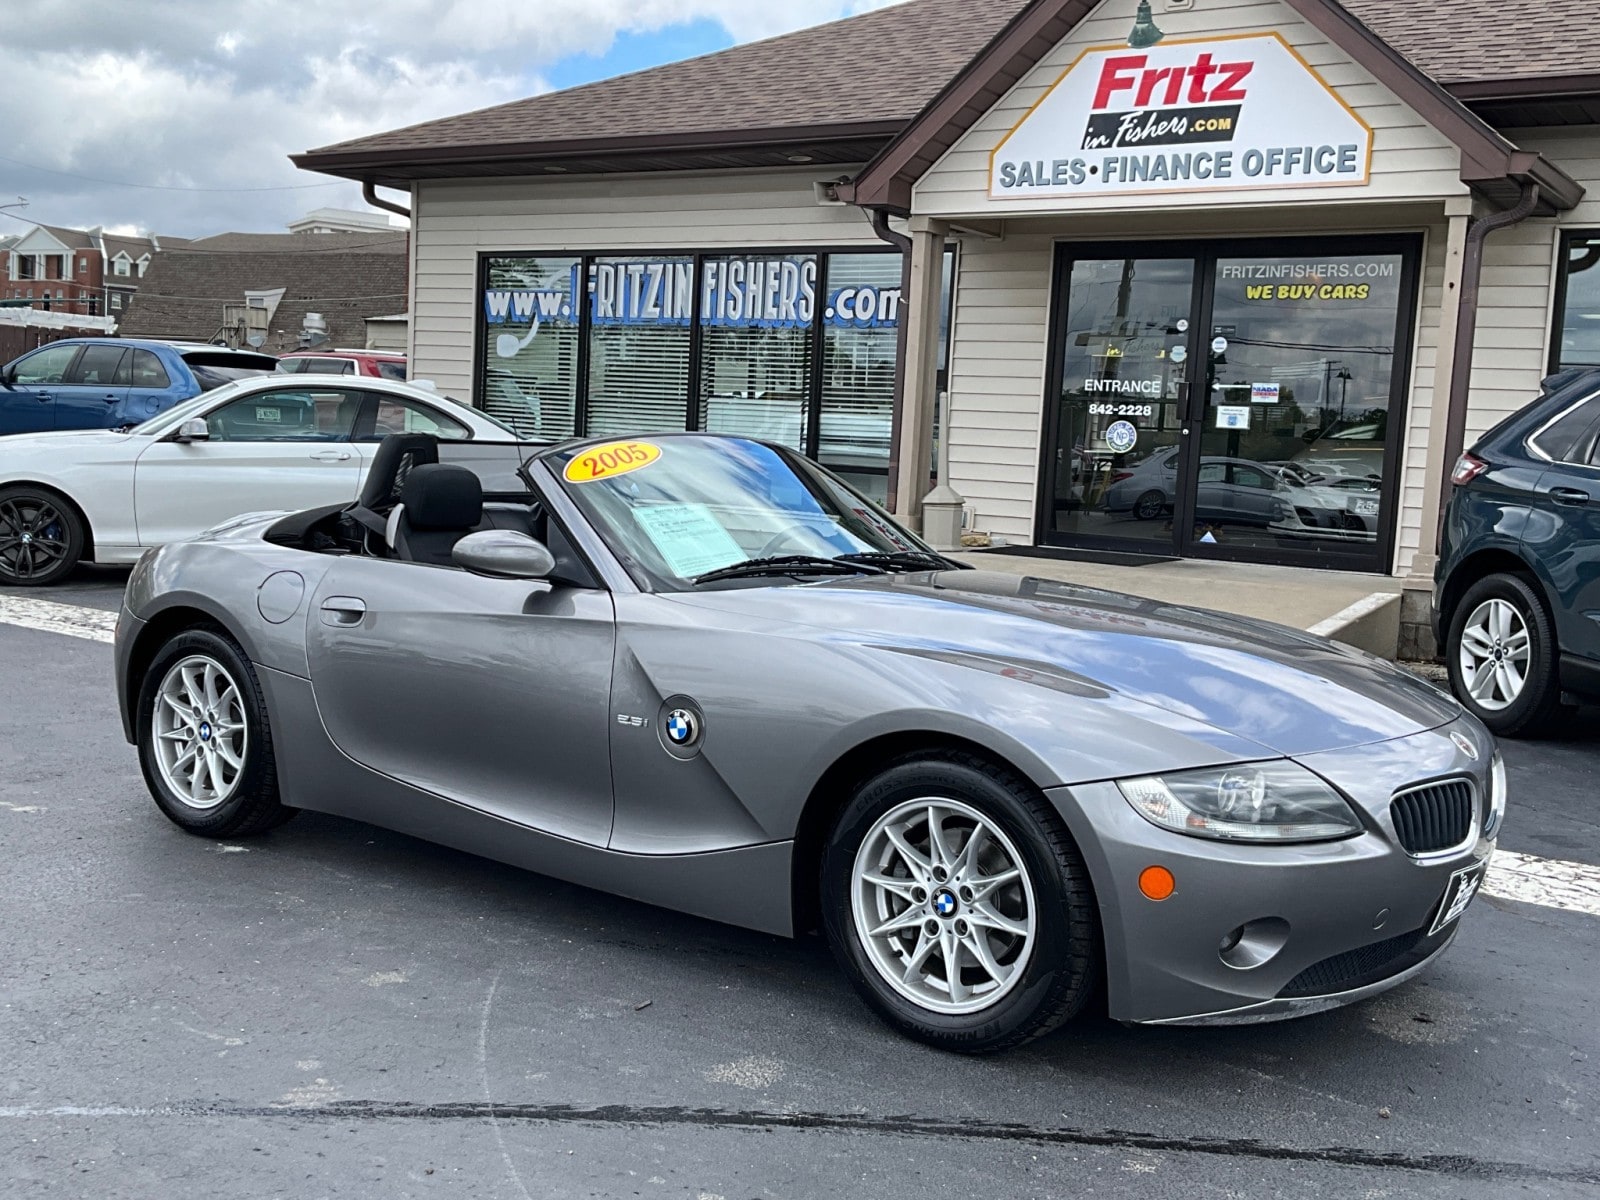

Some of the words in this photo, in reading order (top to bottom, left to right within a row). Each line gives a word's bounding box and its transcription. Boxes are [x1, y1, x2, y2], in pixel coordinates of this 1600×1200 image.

[1092, 53, 1254, 110] Fritz
[1084, 127, 1110, 149] in
[999, 158, 1086, 188] SALES
[1101, 151, 1232, 183] FINANCE
[1241, 144, 1358, 177] OFFICE
[1222, 263, 1393, 279] FRITZINFISHERS.COM
[1246, 284, 1274, 300] WE
[1277, 284, 1316, 299] BUY
[1318, 284, 1370, 299] CARS
[1084, 379, 1161, 393] ENTRANCE
[1089, 404, 1152, 416] 842-2228
[583, 444, 648, 477] 2005
